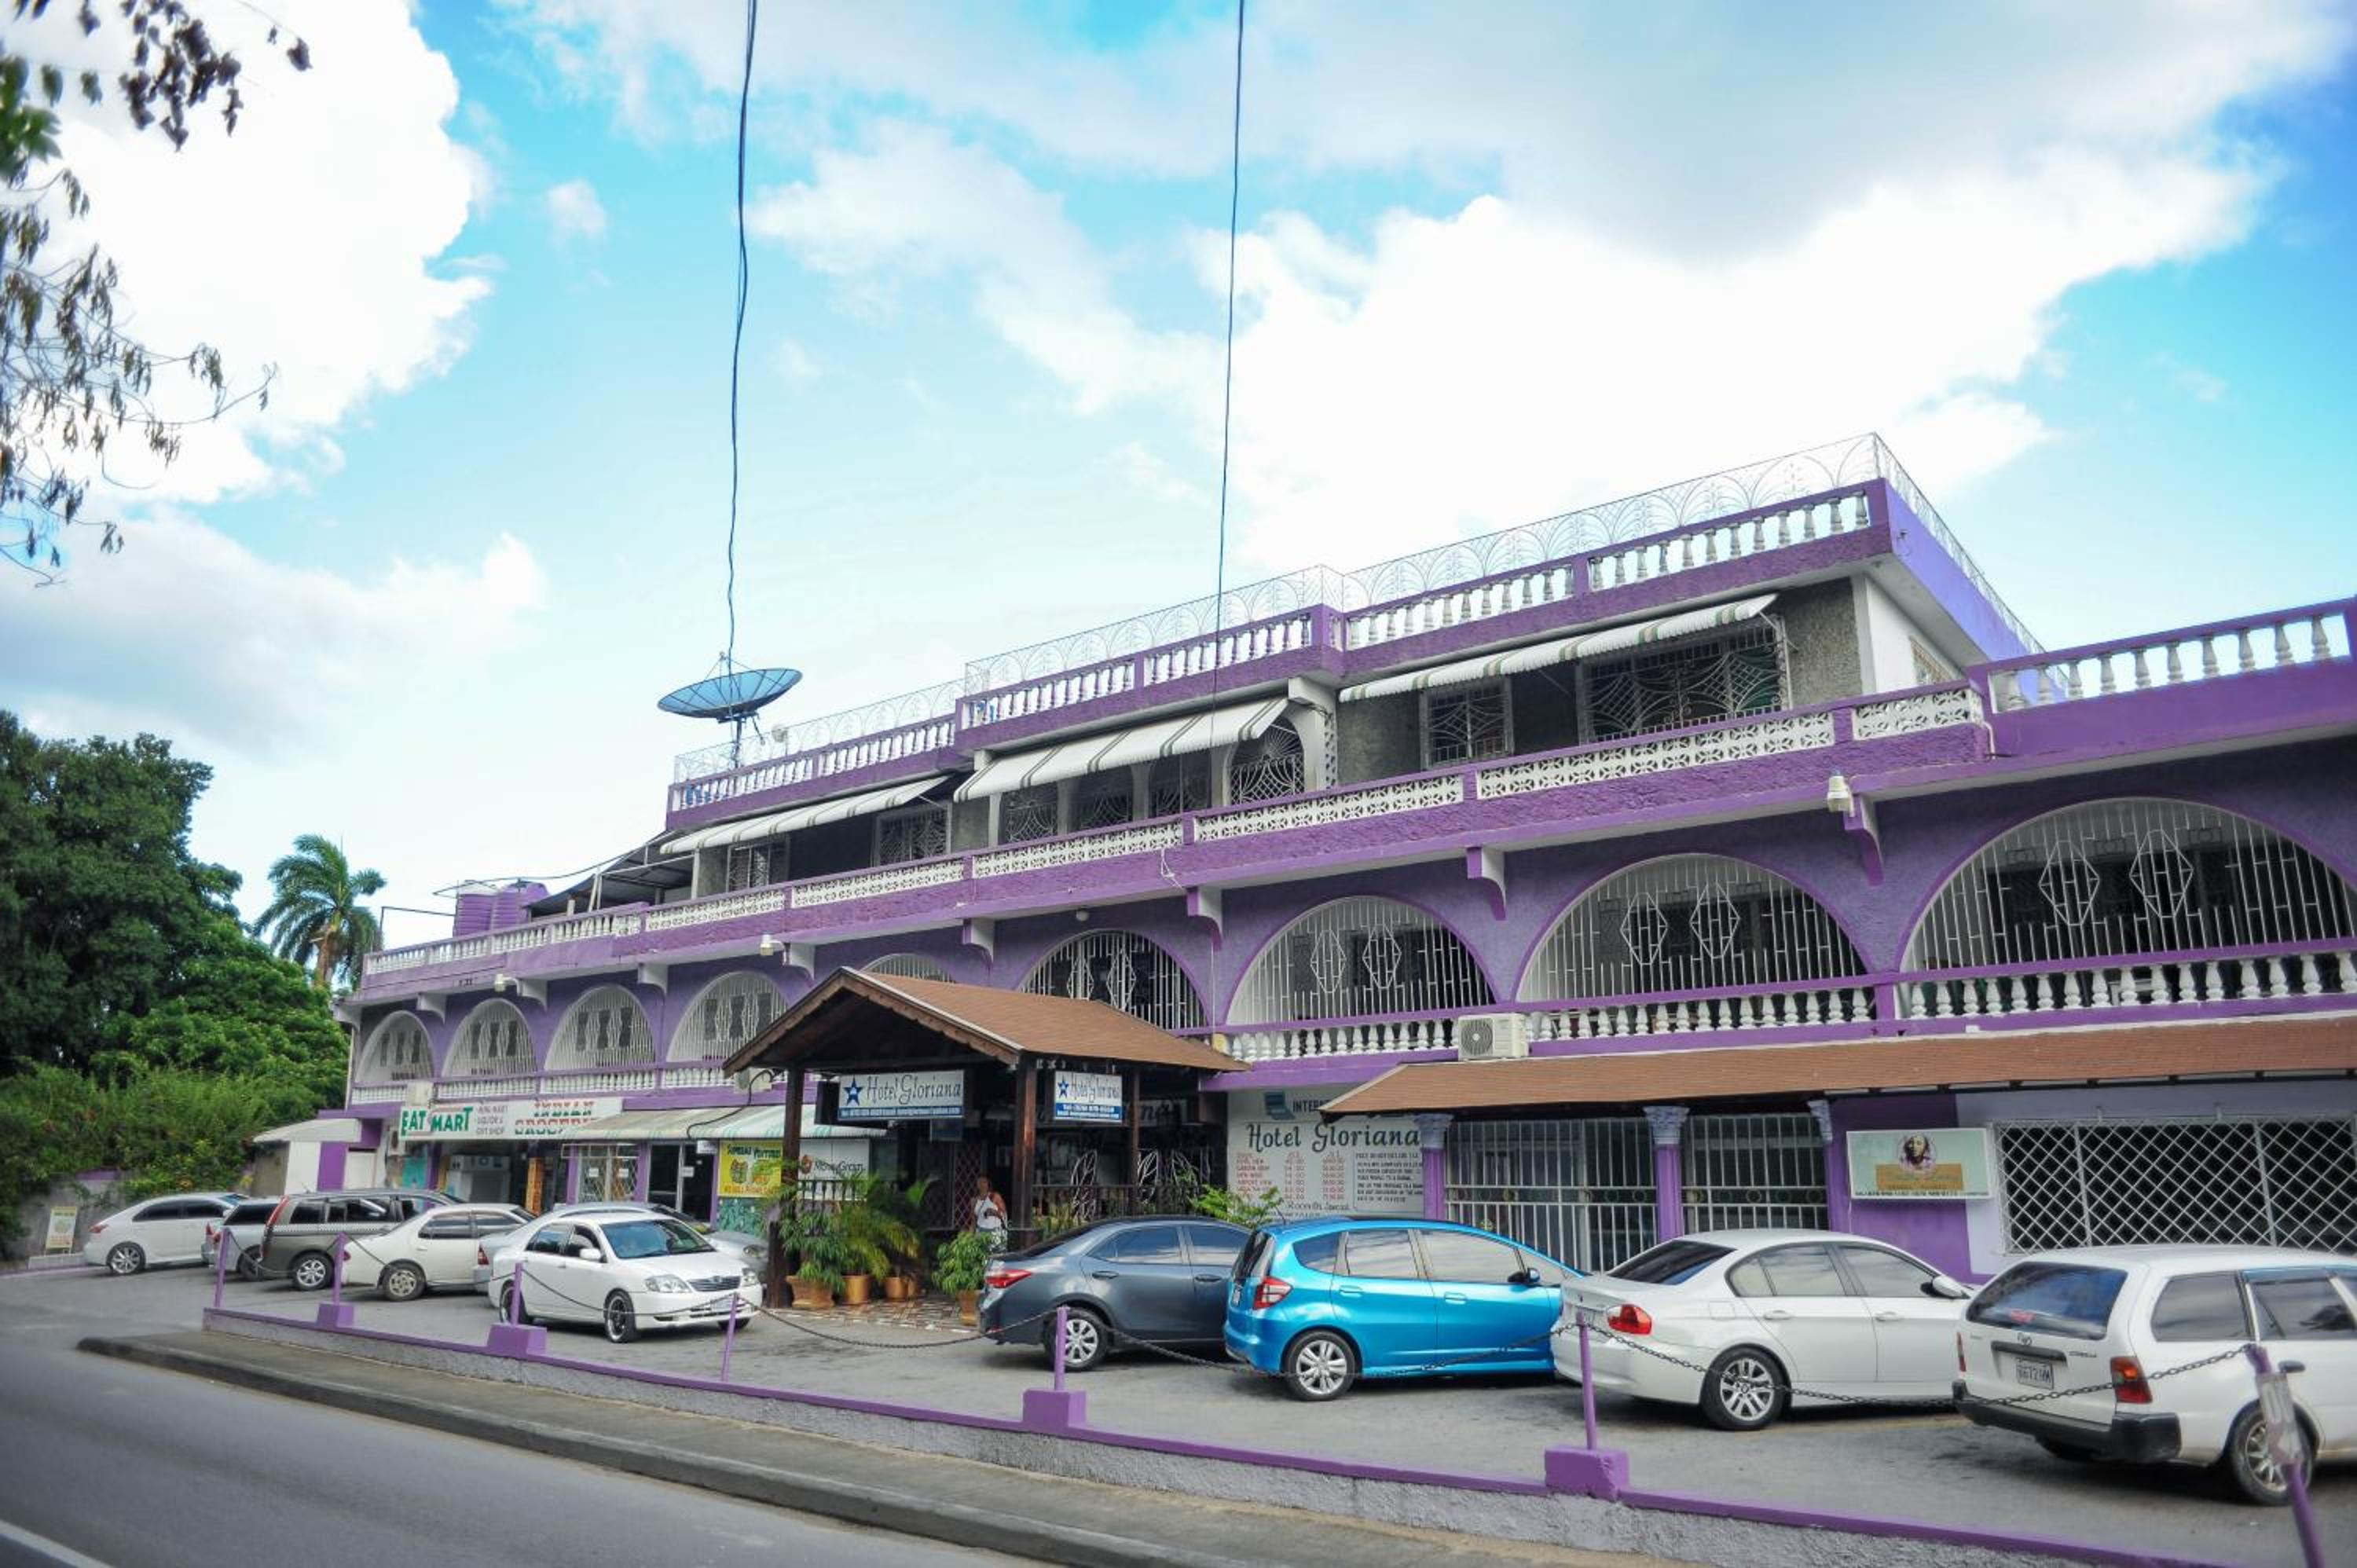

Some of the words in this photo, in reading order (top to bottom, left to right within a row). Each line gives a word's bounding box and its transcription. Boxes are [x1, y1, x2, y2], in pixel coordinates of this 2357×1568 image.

[867, 1075, 897, 1104] Hotel
[899, 1074, 961, 1105] Gloriana
[401, 1110, 427, 1136] EAT
[431, 1106, 473, 1131] MART
[1247, 1123, 1301, 1152] Hotel
[1312, 1123, 1420, 1152] Gloriana
